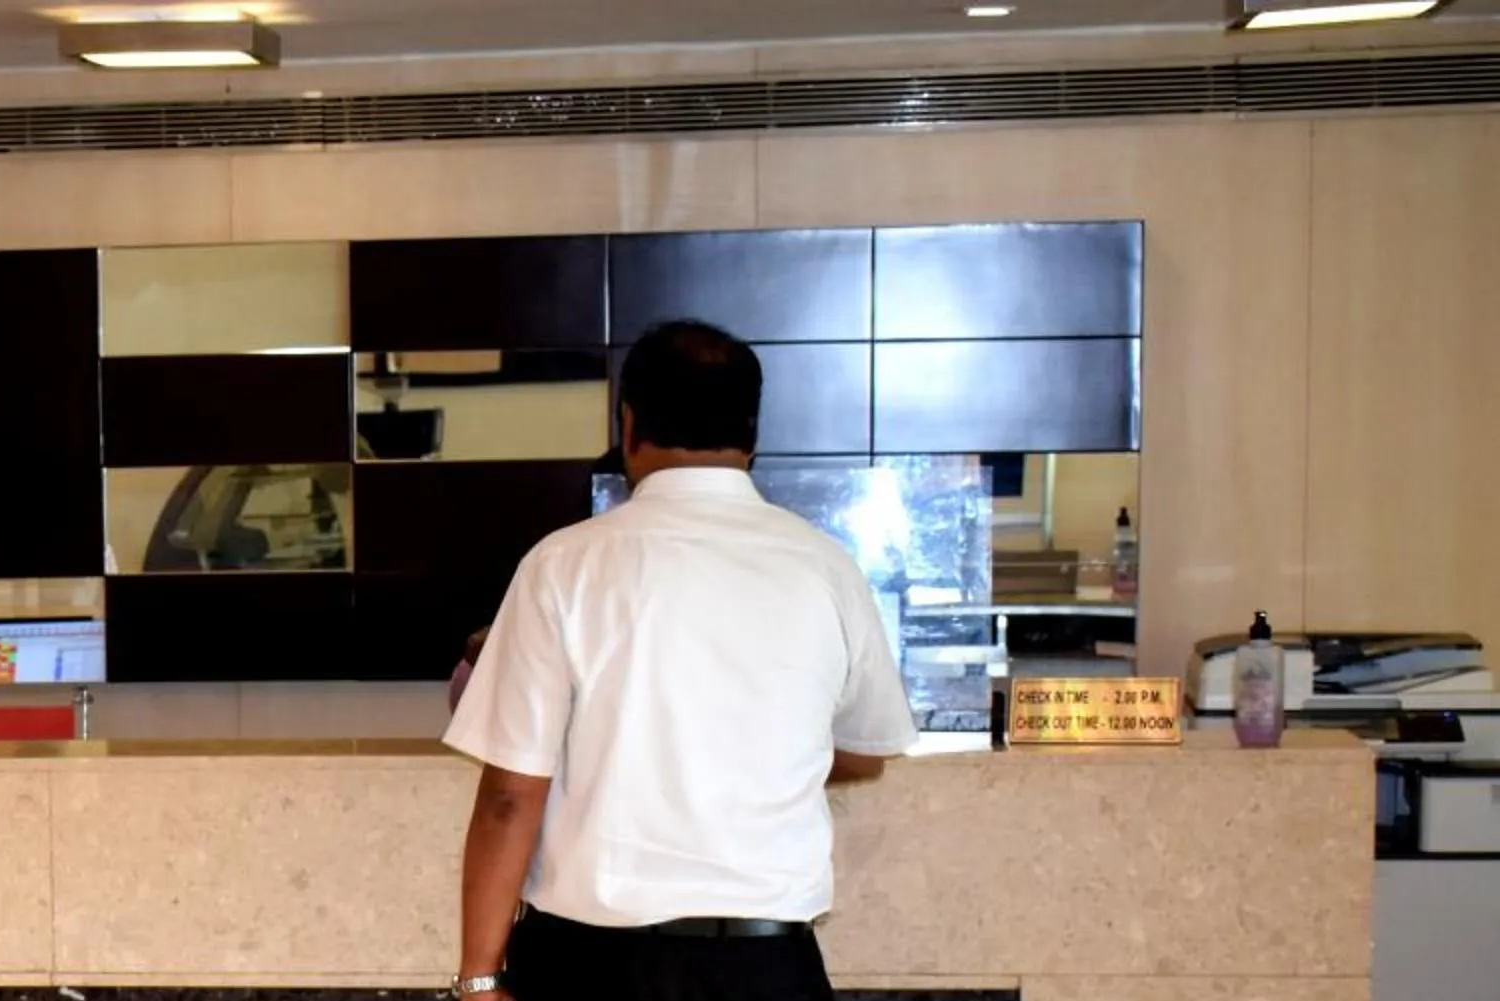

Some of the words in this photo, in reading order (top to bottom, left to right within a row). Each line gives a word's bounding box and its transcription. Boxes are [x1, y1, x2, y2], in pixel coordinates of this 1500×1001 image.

[1017, 690, 1052, 704] CHECK
[1053, 690, 1064, 704] IN
[1067, 690, 1089, 704] TIME
[1115, 690, 1137, 705] 2.00
[1016, 715, 1049, 729] CHECK
[1052, 715, 1073, 729] OUT
[1076, 715, 1098, 729] TIME
[1108, 715, 1137, 730] 12.00
[1139, 716, 1173, 729] NOON
